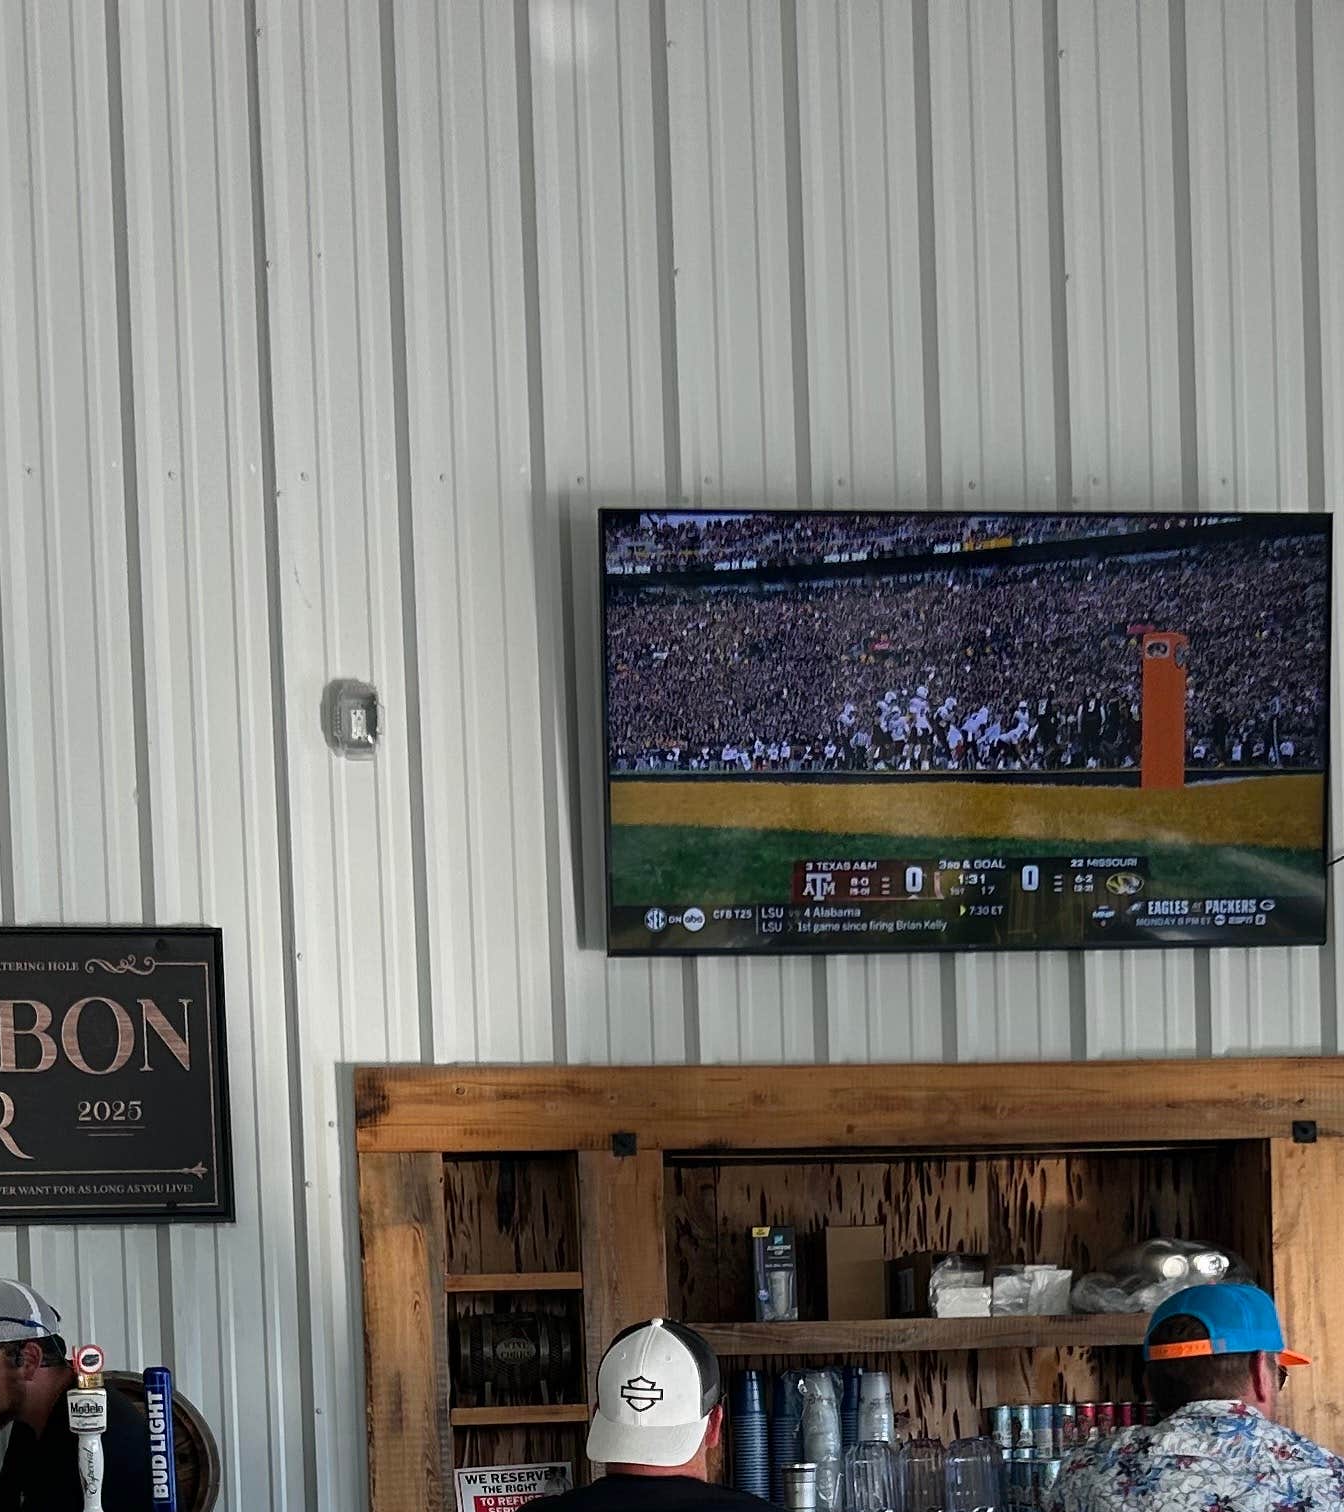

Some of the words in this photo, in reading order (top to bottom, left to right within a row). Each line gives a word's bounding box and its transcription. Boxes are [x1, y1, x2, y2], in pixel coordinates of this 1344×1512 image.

[816, 862, 851, 871] TEXAS
[853, 861, 877, 871] A&M
[973, 859, 1006, 870] GOAL
[1070, 859, 1084, 868] 22
[1086, 858, 1138, 868] MISSOURI
[991, 905, 1003, 916] ET
[1147, 900, 1189, 915] EAGLES
[1205, 899, 1256, 915] PACKERS
[761, 907, 784, 919] LSU
[812, 907, 861, 918] Alabama
[762, 921, 782, 933] LSU
[797, 922, 812, 932] 1st
[813, 923, 840, 934] game
[842, 921, 868, 932] since
[869, 920, 895, 934] firing
[896, 920, 922, 931] Brian
[923, 920, 948, 933] Kelly
[1135, 917, 1176, 928] MONDAY
[48, 961, 80, 972] HOLE
[76, 1100, 143, 1123] 2025
[18, 1185, 51, 1195] WANT
[53, 1185, 75, 1195] FOR
[78, 1185, 92, 1195] AS
[93, 1185, 125, 1195] LONG
[126, 1184, 140, 1194] AS
[141, 1184, 164, 1194] YOU
[71, 1402, 103, 1414] Modelo
[147, 1391, 167, 1452] LIGHT
[152, 1455, 170, 1498] BUD
[465, 1473, 486, 1485] WE
[491, 1470, 552, 1484] RESERVE
[482, 1485, 502, 1494] THE
[505, 1483, 538, 1493] RIGHT
[480, 1497, 495, 1506] TO
